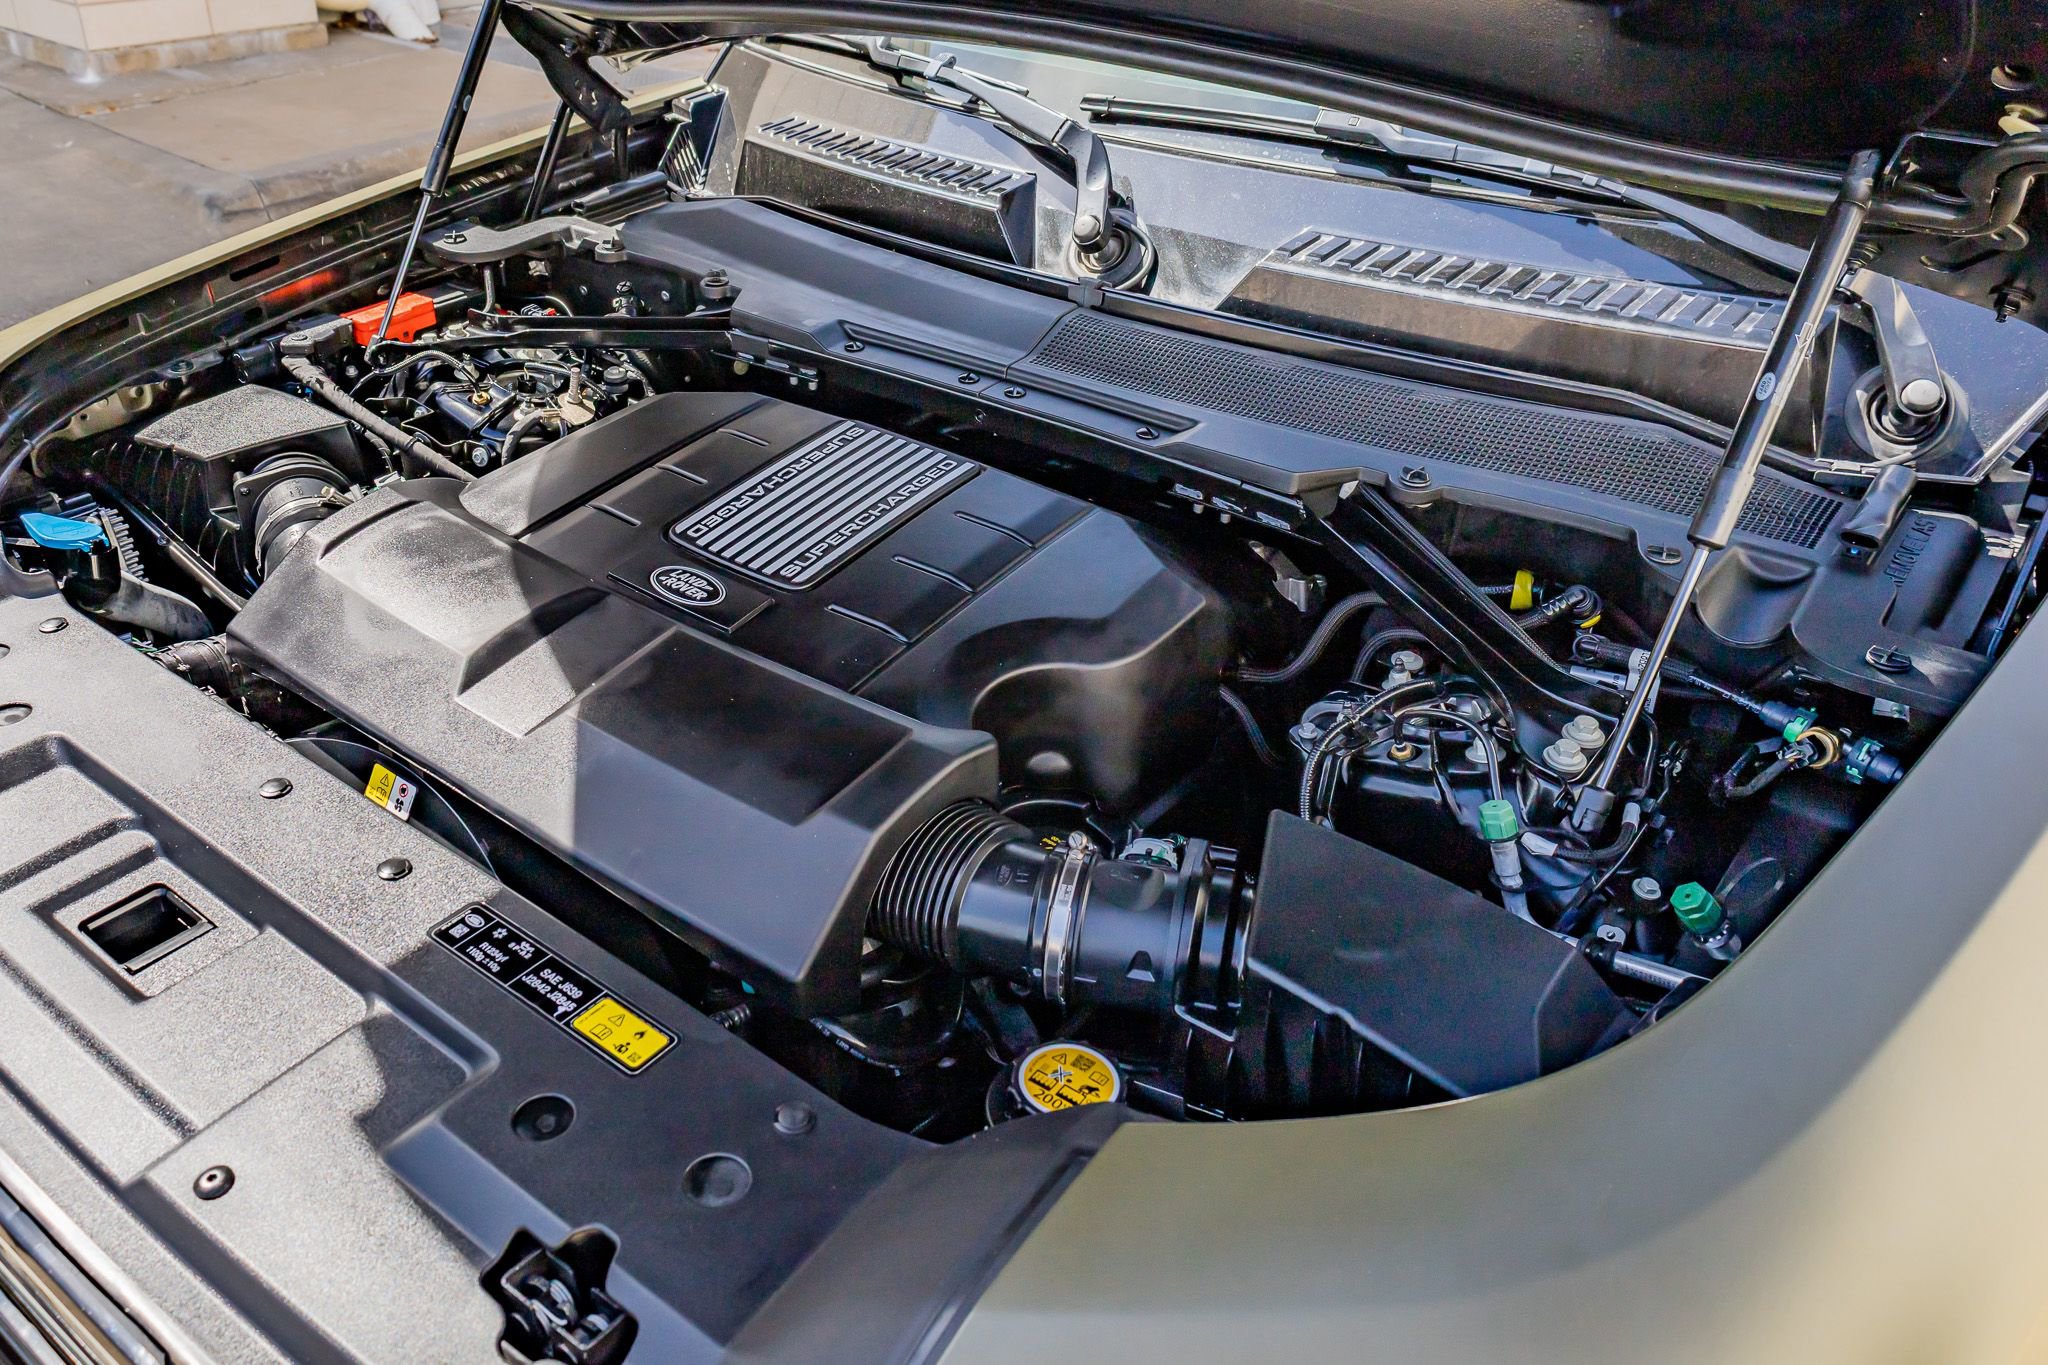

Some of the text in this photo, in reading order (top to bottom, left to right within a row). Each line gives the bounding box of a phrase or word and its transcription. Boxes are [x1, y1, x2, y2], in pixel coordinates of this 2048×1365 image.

[687, 426, 865, 538] SUPERCHARGED
[780, 459, 958, 578] SUPERCHARGED
[665, 576, 709, 601] ROVER
[668, 568, 703, 589] LAND
[479, 941, 510, 963] R1234yf
[521, 973, 578, 1012] J2842 J2845
[540, 968, 583, 999] SAE J639
